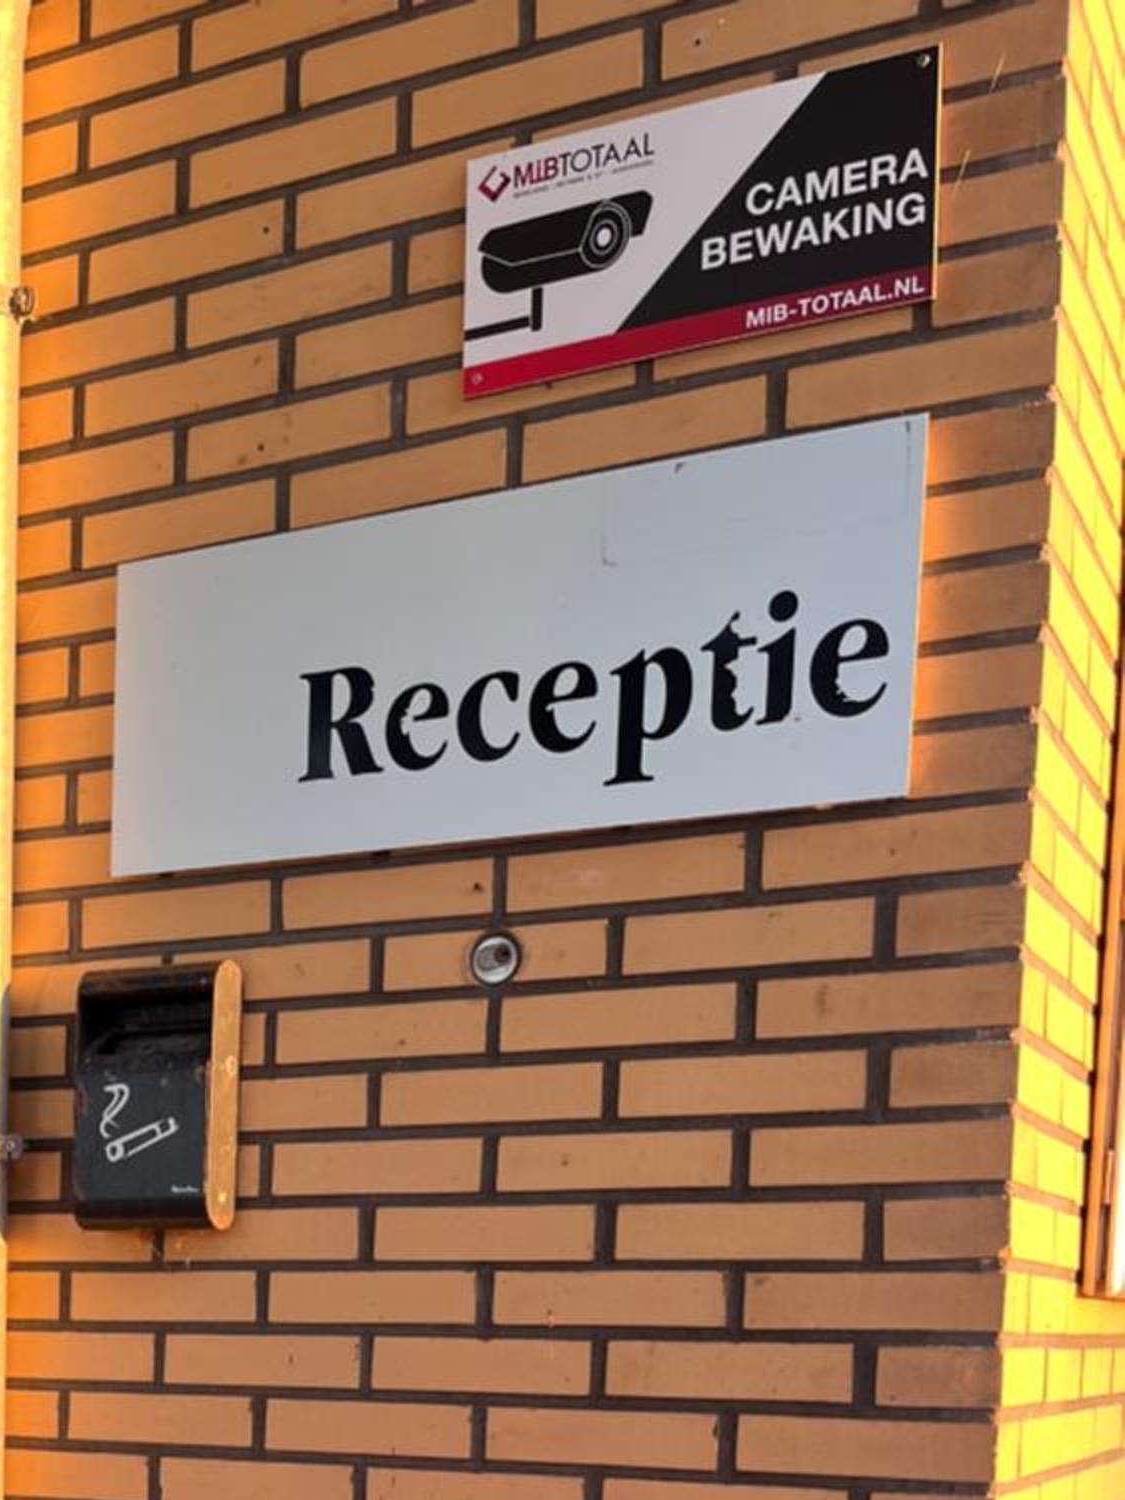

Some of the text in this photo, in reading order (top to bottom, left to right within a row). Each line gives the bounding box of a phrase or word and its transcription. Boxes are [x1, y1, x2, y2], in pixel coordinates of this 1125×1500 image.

[745, 147, 929, 216] CAMERA
[701, 192, 926, 271] BEWAKING
[746, 275, 925, 328] MIB-TOTAAL.NL
[297, 590, 890, 786] Receptie
